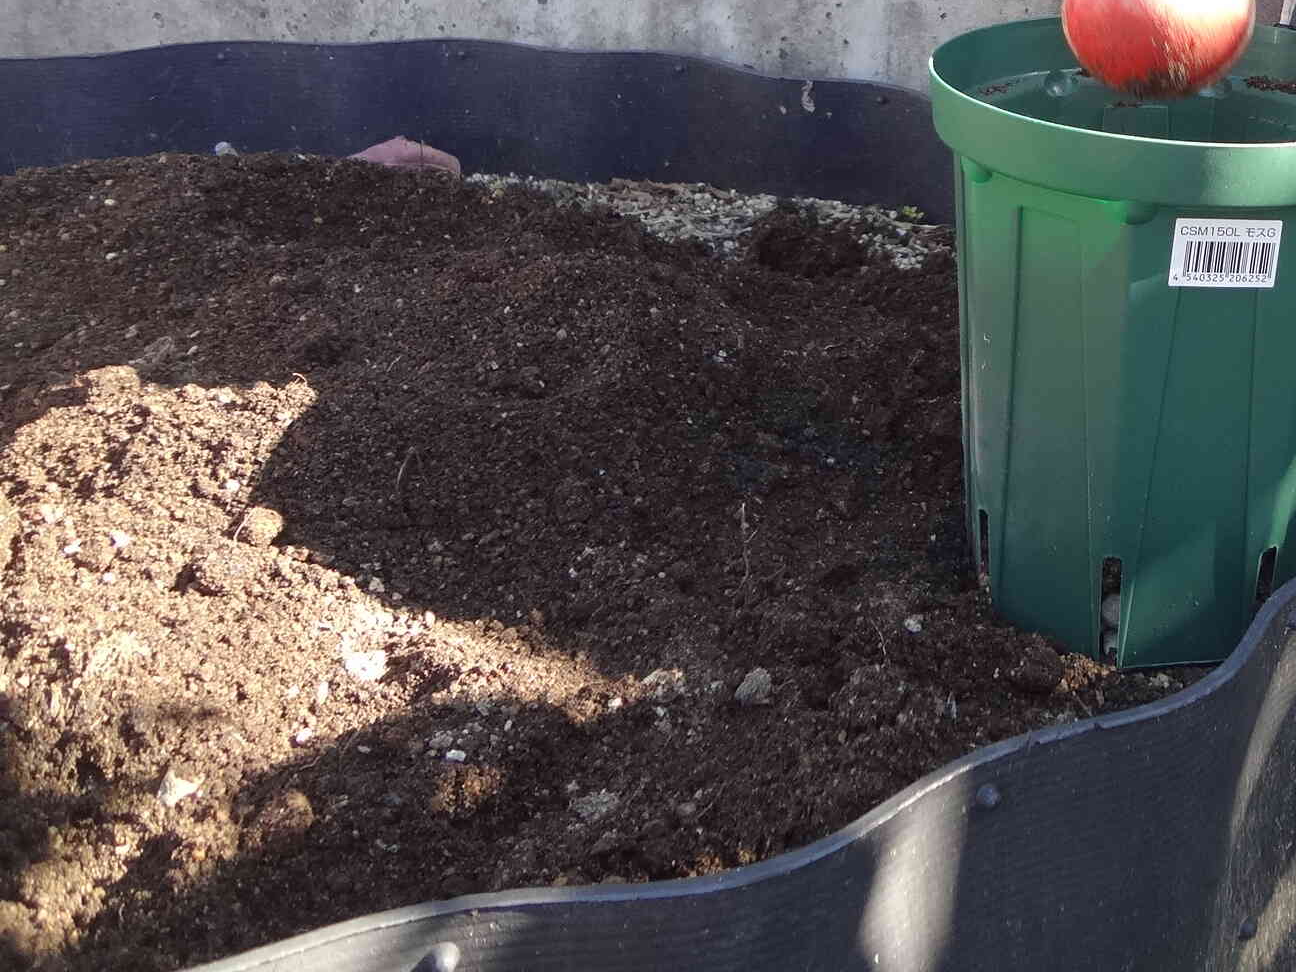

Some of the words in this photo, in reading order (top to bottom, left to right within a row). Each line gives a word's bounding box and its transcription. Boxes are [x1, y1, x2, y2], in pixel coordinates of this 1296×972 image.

[1180, 225, 1241, 237] CSM150L
[1186, 273, 1225, 282] 540325
[1229, 274, 1267, 283] 206252
